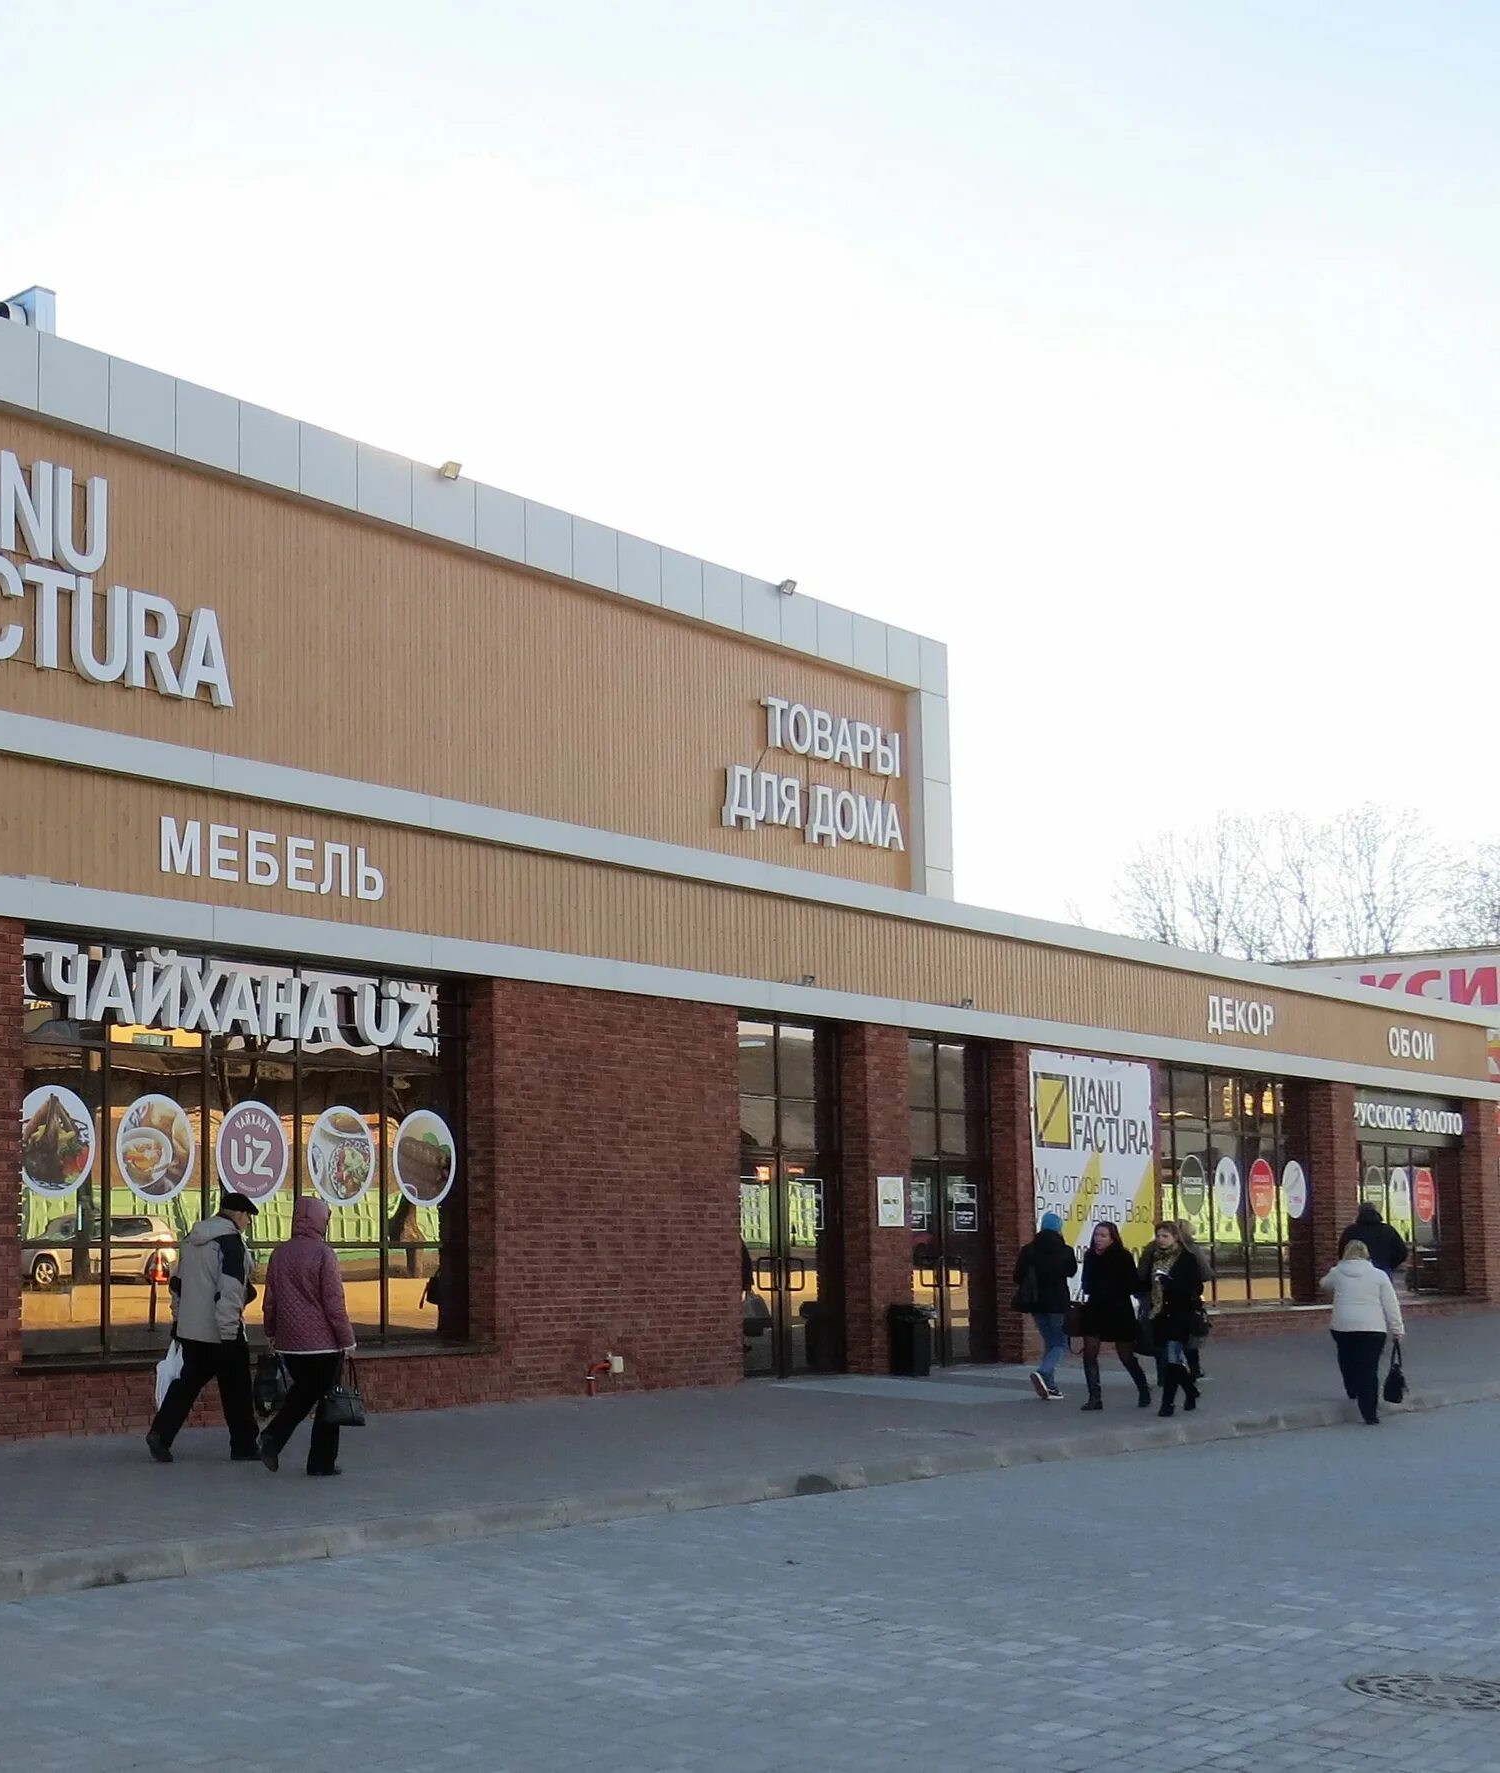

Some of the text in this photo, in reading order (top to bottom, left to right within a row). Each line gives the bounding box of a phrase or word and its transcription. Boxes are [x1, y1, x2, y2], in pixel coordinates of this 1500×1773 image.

[760, 696, 901, 779] ТОВАРЫ
[722, 764, 905, 851] ДЛЯ ДОМА
[159, 815, 385, 902] МЕБЕЛЬ
[44, 946, 341, 1045] ЧАЙХАНА
[1207, 995, 1275, 1037] ДЕКОР
[1388, 1026, 1435, 1061] ОБОИ
[1071, 1075, 1122, 1117] MANU
[1072, 1114, 1150, 1155] FACTURA
[1414, 1107, 1464, 1136] ЗОЛОТО
[1035, 1167, 1059, 1193] Мы
